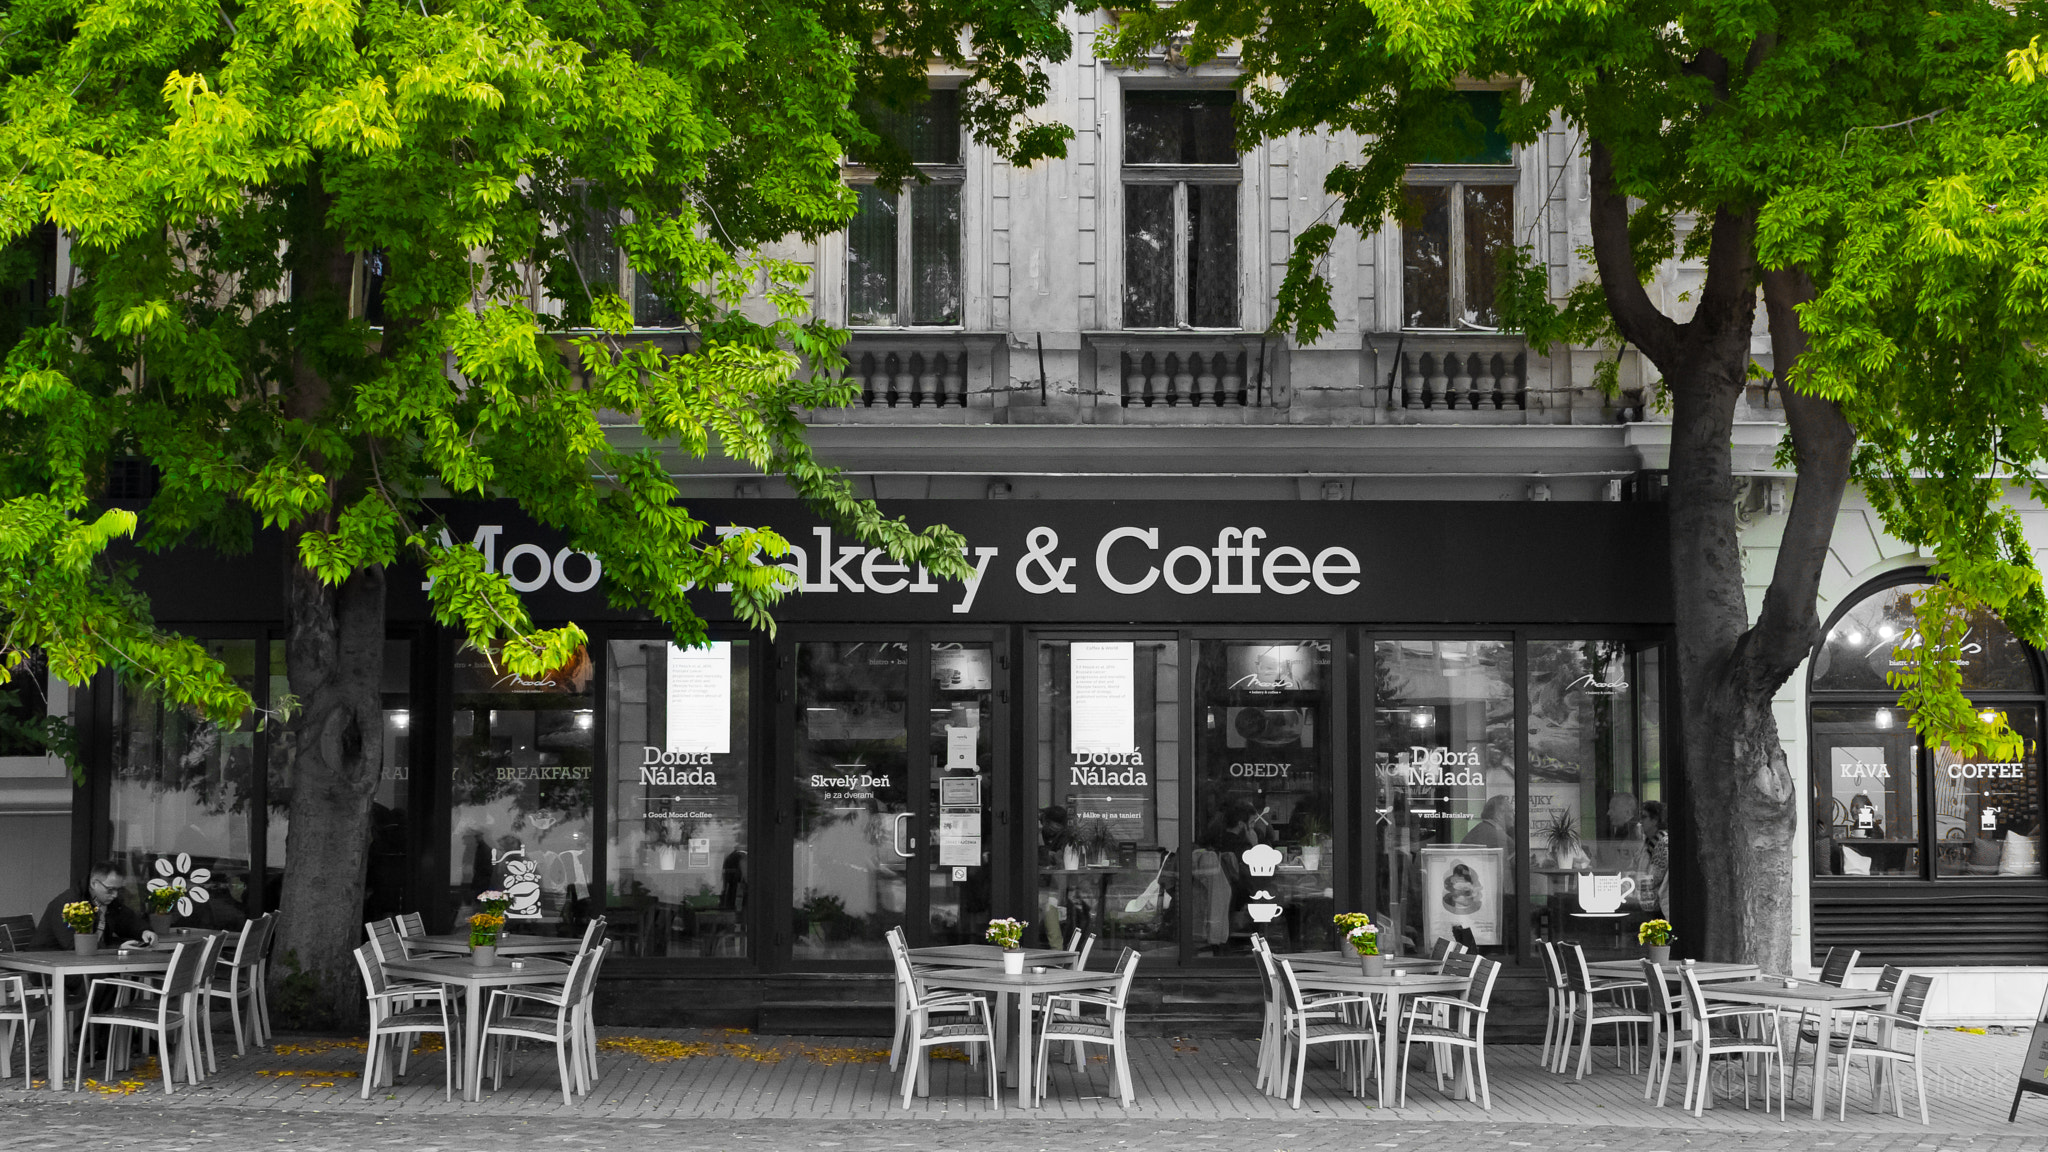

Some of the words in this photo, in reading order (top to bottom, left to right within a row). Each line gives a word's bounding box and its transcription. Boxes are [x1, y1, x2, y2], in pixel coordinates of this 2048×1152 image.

[421, 525, 695, 594] Moo
[1016, 526, 1077, 594] &
[1096, 526, 1361, 595] Coffee
[1229, 673, 1293, 690] Moods
[1565, 673, 1629, 690] Moods
[643, 745, 713, 765] Dobrá
[1074, 746, 1144, 766] Dobrá
[1410, 746, 1481, 766] Dobrá
[496, 766, 592, 780] BREAKFAST
[639, 766, 717, 786] Nálada
[1070, 766, 1148, 786] Nálada
[1229, 763, 1291, 777] OBEDY
[1407, 767, 1485, 786] Nálada
[1840, 760, 1891, 778] KÁVA
[1948, 763, 2024, 779] COFFEE
[811, 775, 858, 790] Skvelý
[861, 774, 890, 787] Deň
[824, 791, 832, 800] je
[843, 791, 874, 799] dverami
[648, 811, 667, 819] Good
[668, 811, 688, 819] Mood
[689, 811, 713, 819] Coffee
